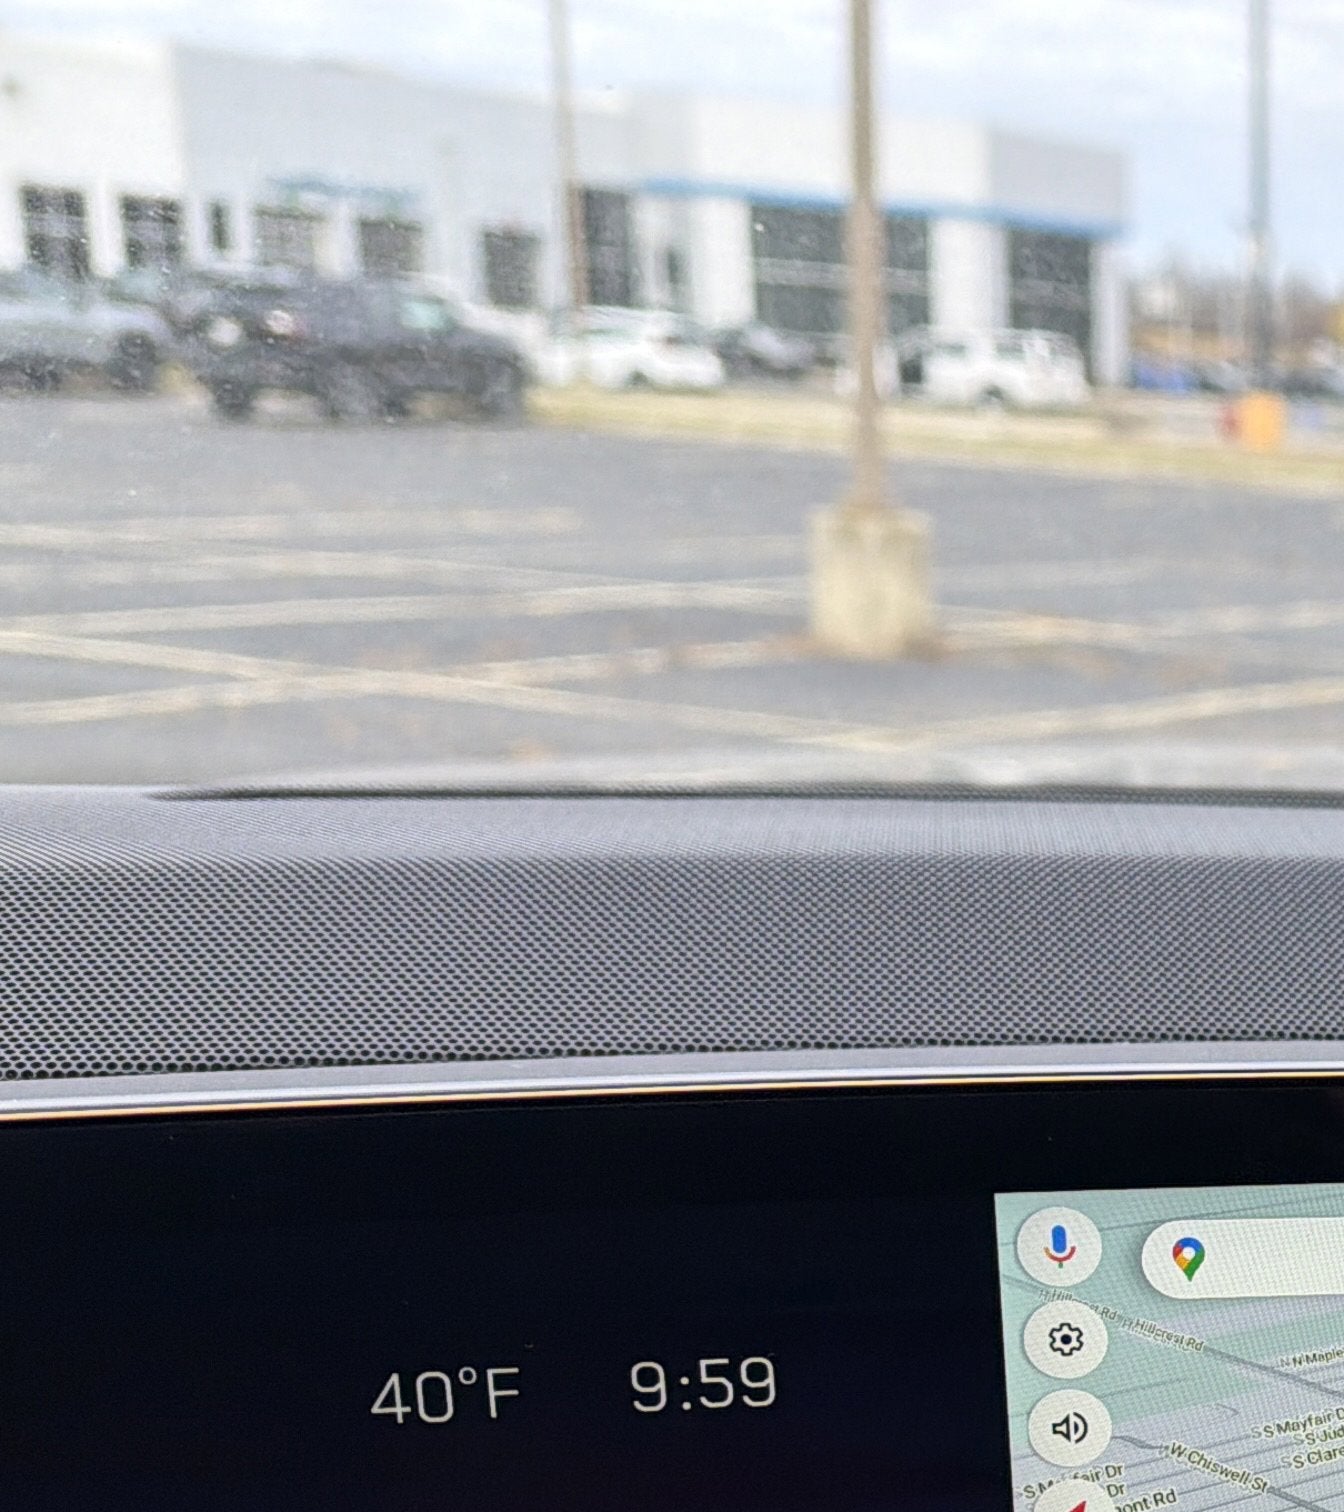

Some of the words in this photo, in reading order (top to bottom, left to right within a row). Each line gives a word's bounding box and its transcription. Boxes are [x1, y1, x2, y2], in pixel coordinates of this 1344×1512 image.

[1102, 1307, 1116, 1320] Rd
[1186, 1338, 1204, 1350] Rd
[1305, 1348, 1338, 1365] Maple
[630, 1356, 777, 1413] 9:59
[370, 1367, 520, 1424] 40°F
[1276, 1411, 1333, 1434] Mayfair
[1169, 1442, 1187, 1460] W
[1187, 1448, 1250, 1486] Chiswell
[1250, 1476, 1268, 1493] St
[1024, 1485, 1035, 1499] S
[1105, 1465, 1123, 1478] Dr
[1107, 1484, 1125, 1498] Dr
[1153, 1489, 1177, 1507] Rd
